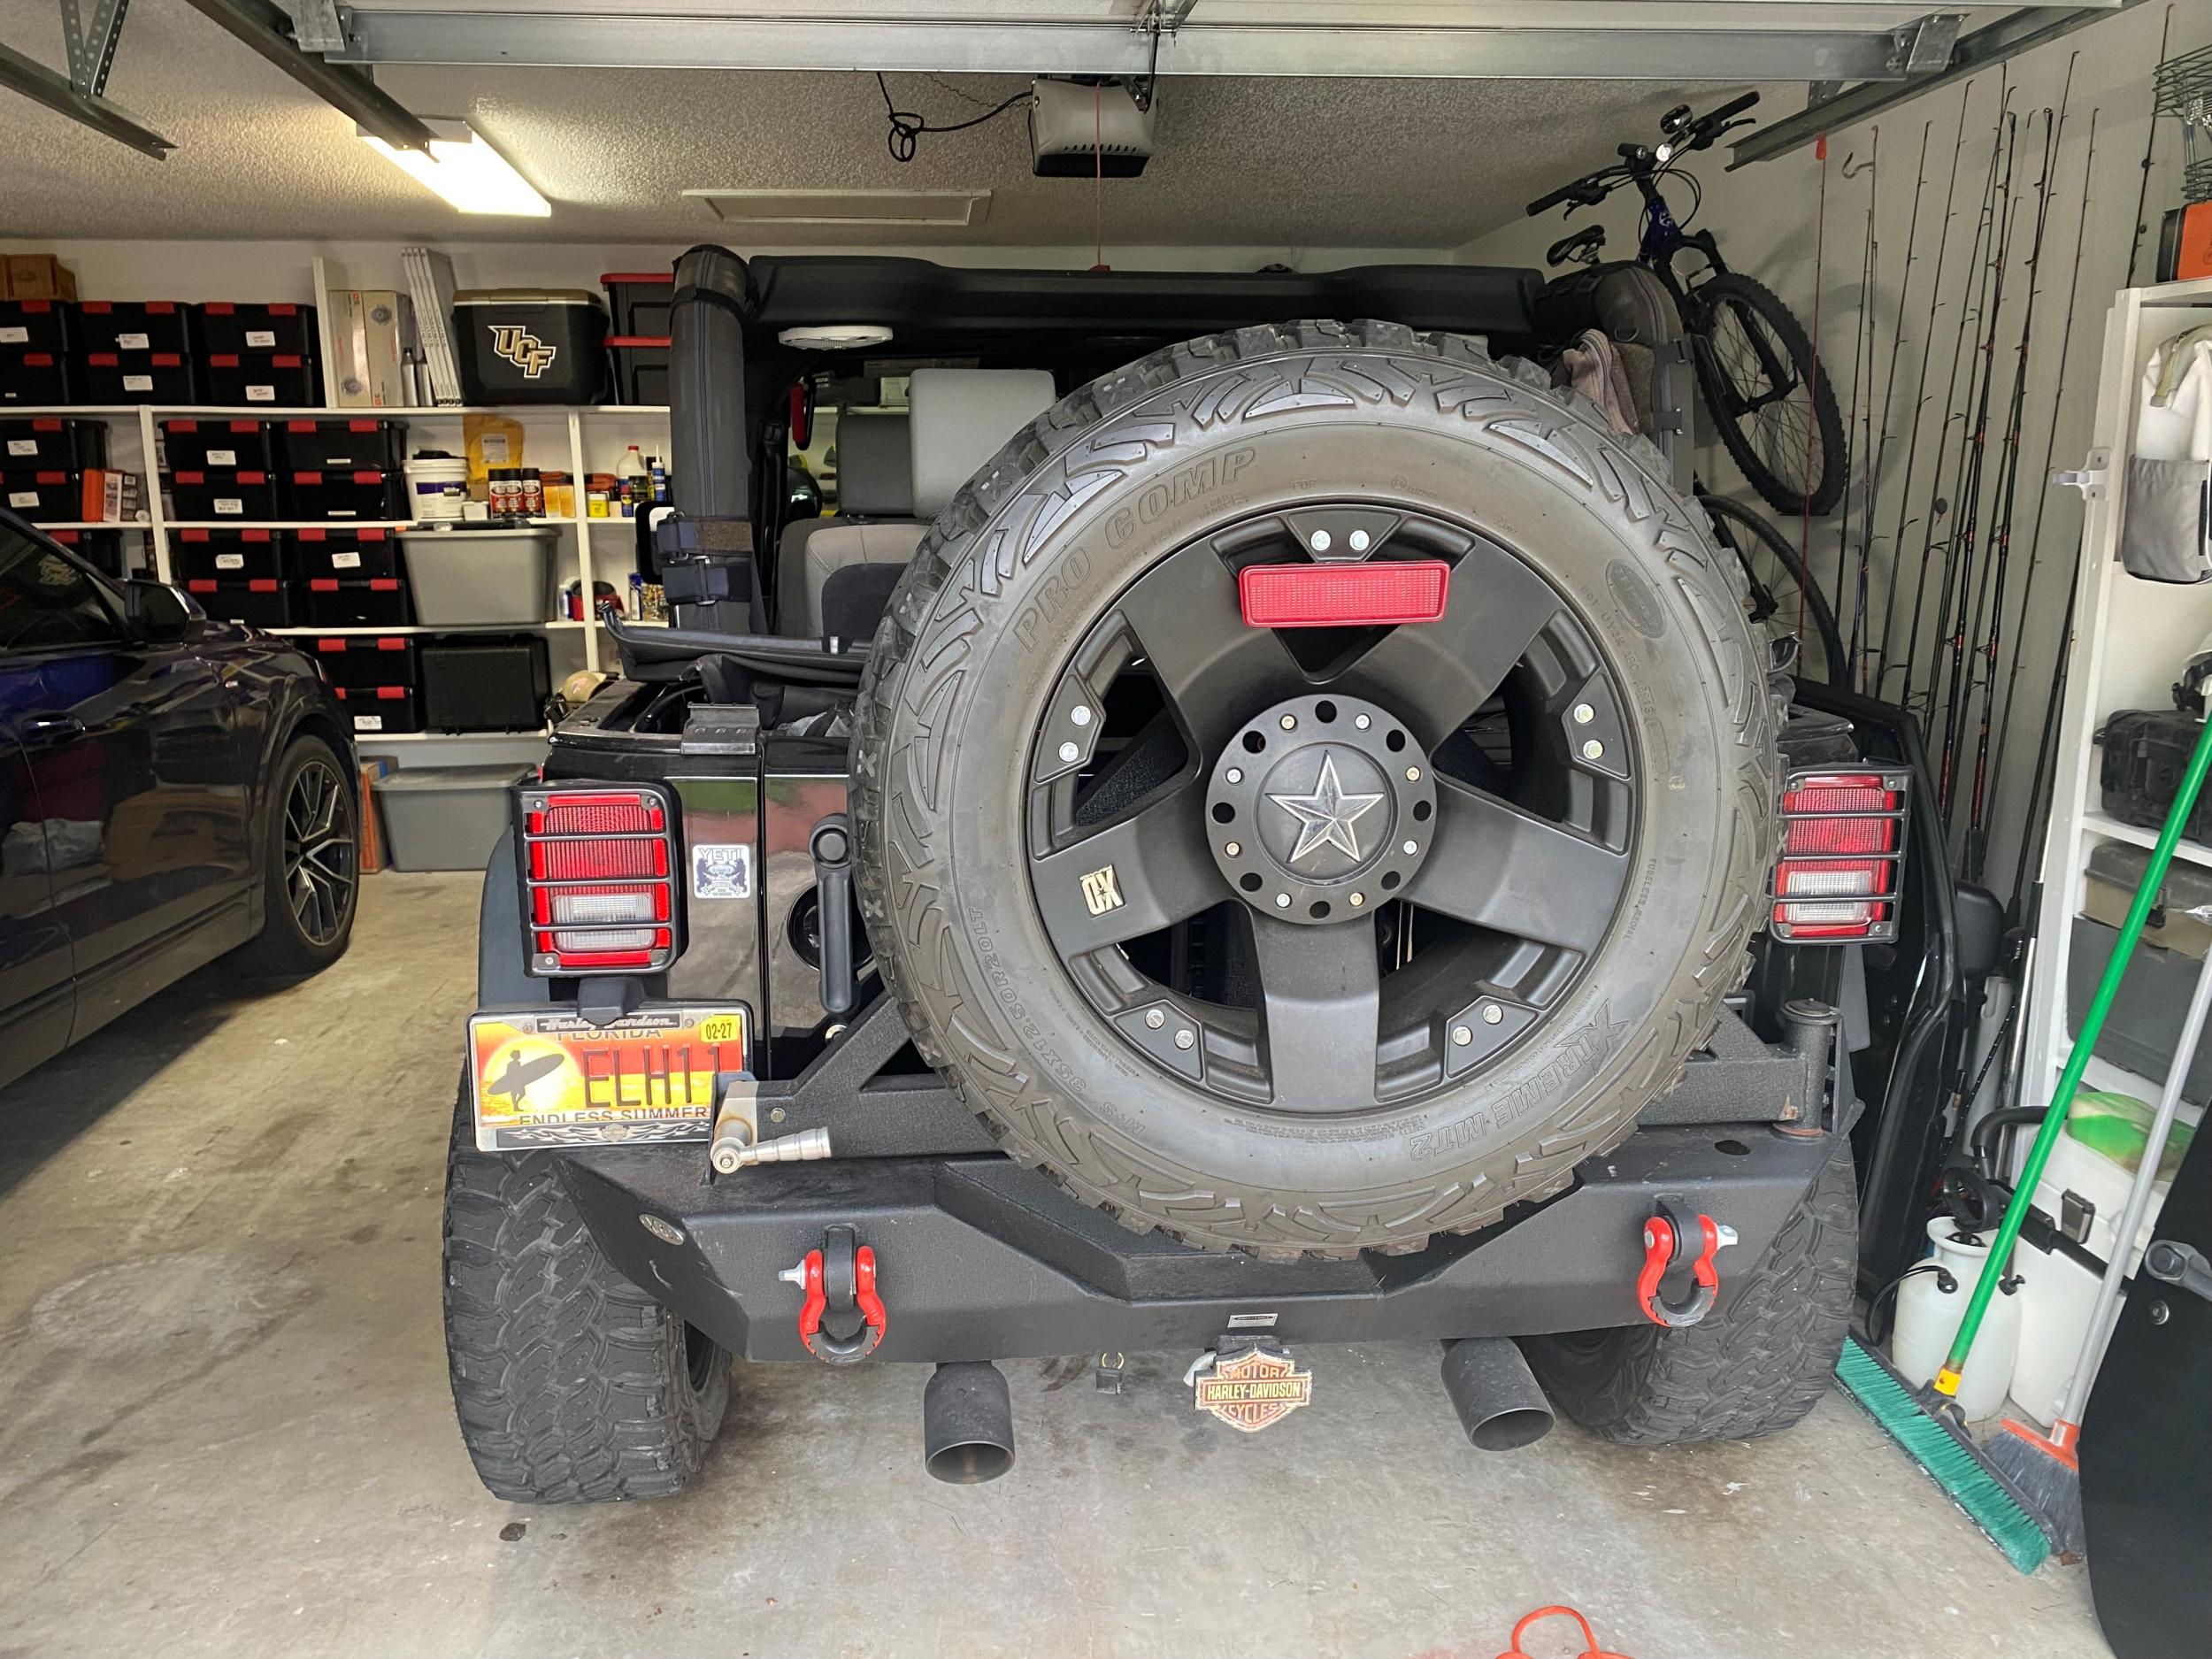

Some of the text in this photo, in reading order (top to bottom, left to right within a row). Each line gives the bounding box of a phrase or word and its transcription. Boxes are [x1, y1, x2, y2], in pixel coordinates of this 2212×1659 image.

[491, 326, 556, 378] UCF
[1013, 446, 1256, 653] PRO COMP
[697, 847, 743, 862] YETI
[968, 908, 1087, 1092] 35X12.50R20LT
[705, 1022, 733, 1040] 02-27
[581, 1043, 721, 1108] ELH11
[1492, 998, 1630, 1129] XTREME
[1099, 1101, 1146, 1135] M+S
[1409, 1112, 1486, 1162] MT2
[1207, 1381, 1301, 1401] HARLEY-DAVIDSON
[1229, 1362, 1281, 1379] MOTOR
[1227, 1402, 1280, 1425] CYCLES
